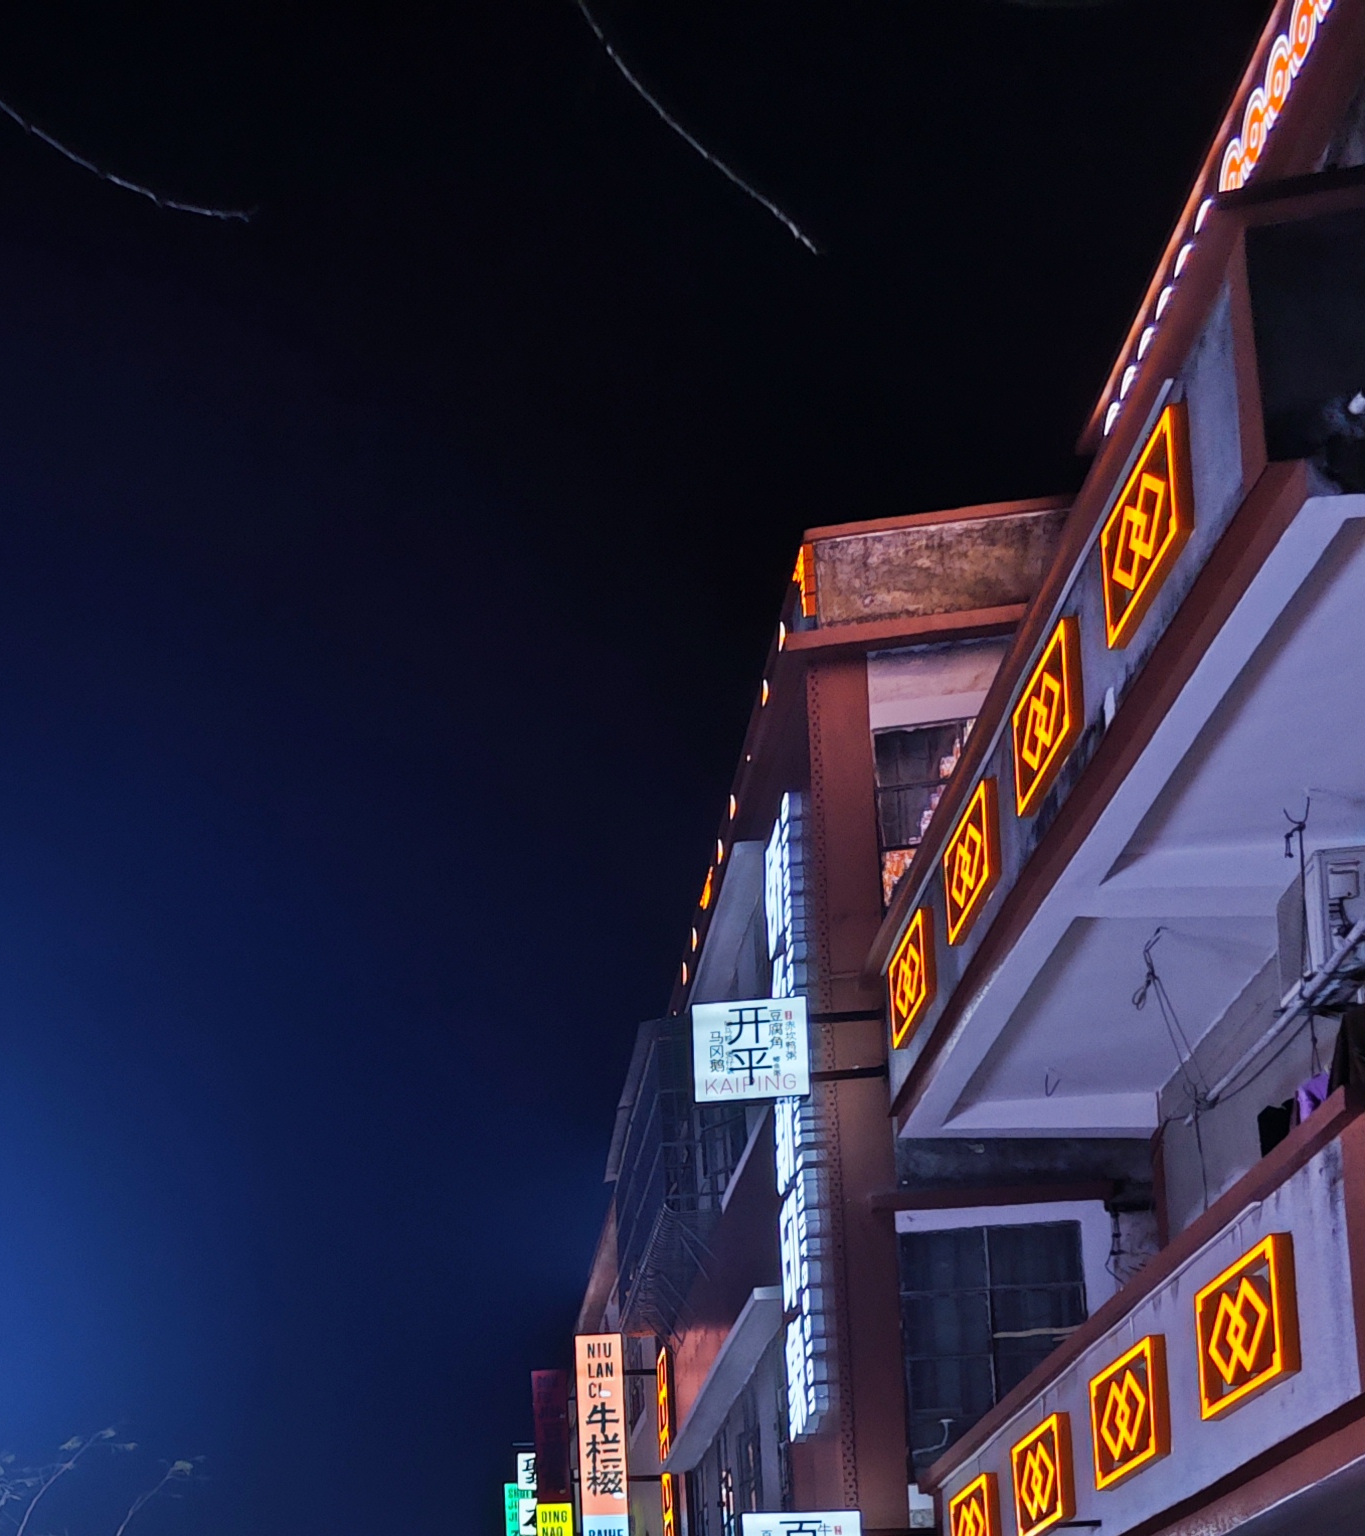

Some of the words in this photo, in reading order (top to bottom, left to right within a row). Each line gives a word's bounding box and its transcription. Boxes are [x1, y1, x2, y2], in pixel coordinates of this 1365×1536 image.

[727, 1006, 772, 1085] 开平
[705, 1073, 797, 1095] KAIPING
[587, 1343, 611, 1359] NIU
[587, 1362, 614, 1378] LAN
[585, 1402, 623, 1497] 牛栏糍
[541, 1510, 568, 1524] DING
